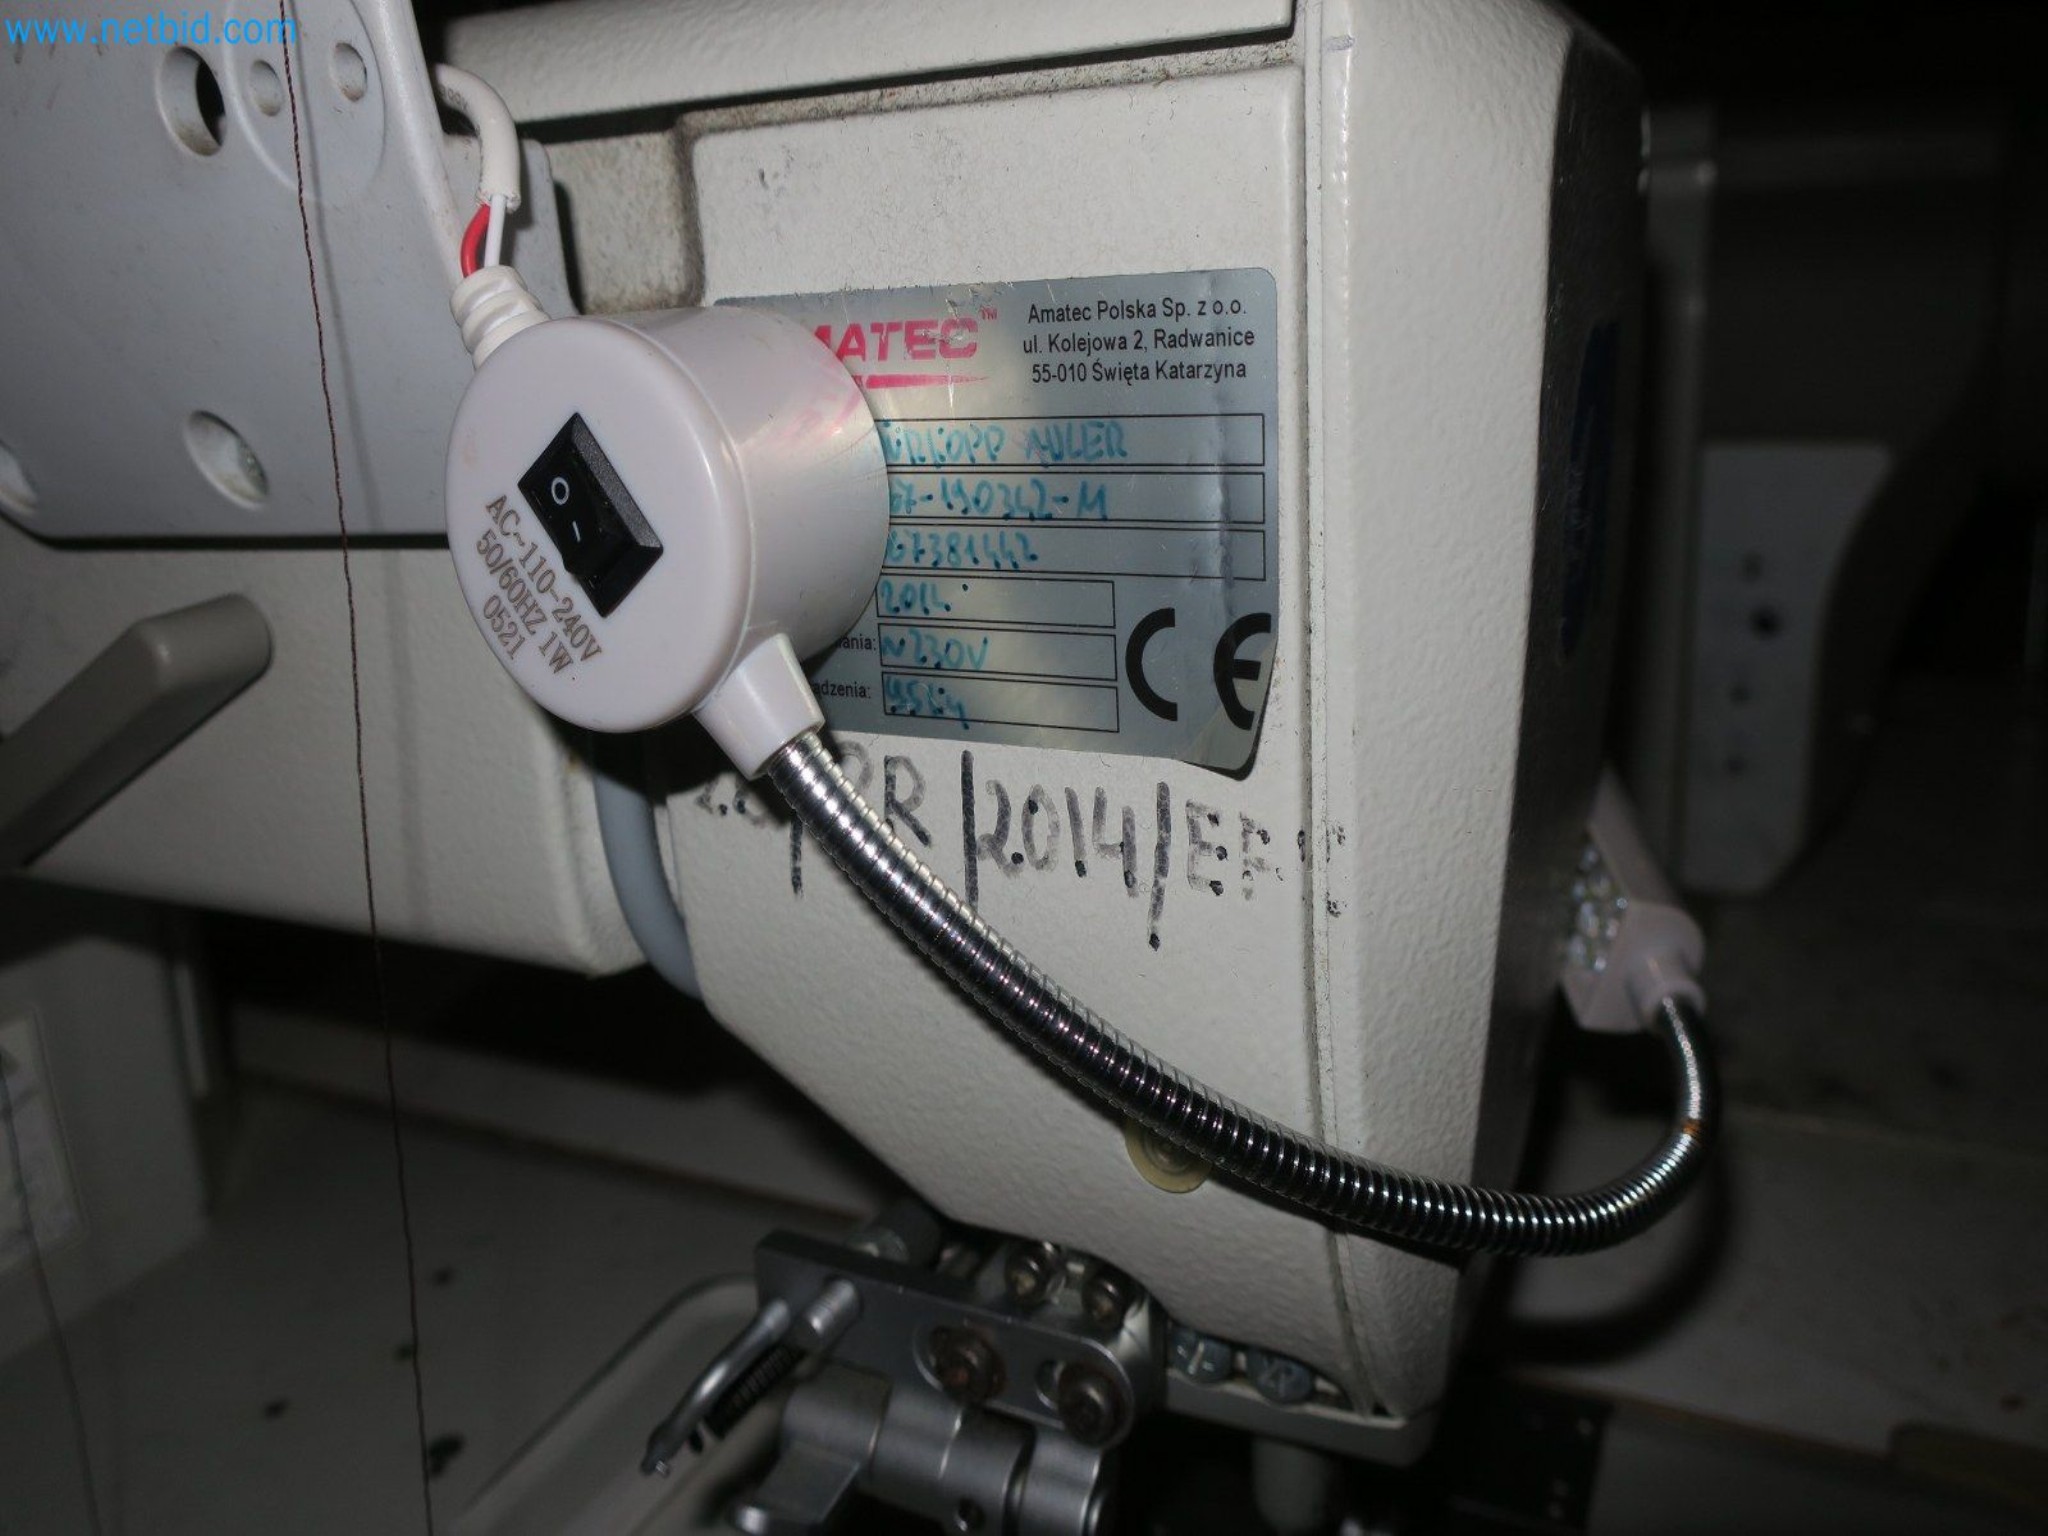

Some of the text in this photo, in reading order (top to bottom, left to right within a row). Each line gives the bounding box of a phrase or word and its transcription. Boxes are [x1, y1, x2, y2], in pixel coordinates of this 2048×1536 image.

[1028, 297, 1247, 323] Amatec Polska Sp. z o.o.
[814, 317, 979, 362] ATEC
[1023, 326, 1255, 357] ul. Kolejowa 2, Radwanice
[1032, 358, 1247, 386] 55-010 Święta Katarzyna
[483, 594, 526, 660] 0521
[538, 631, 574, 674] 1W
